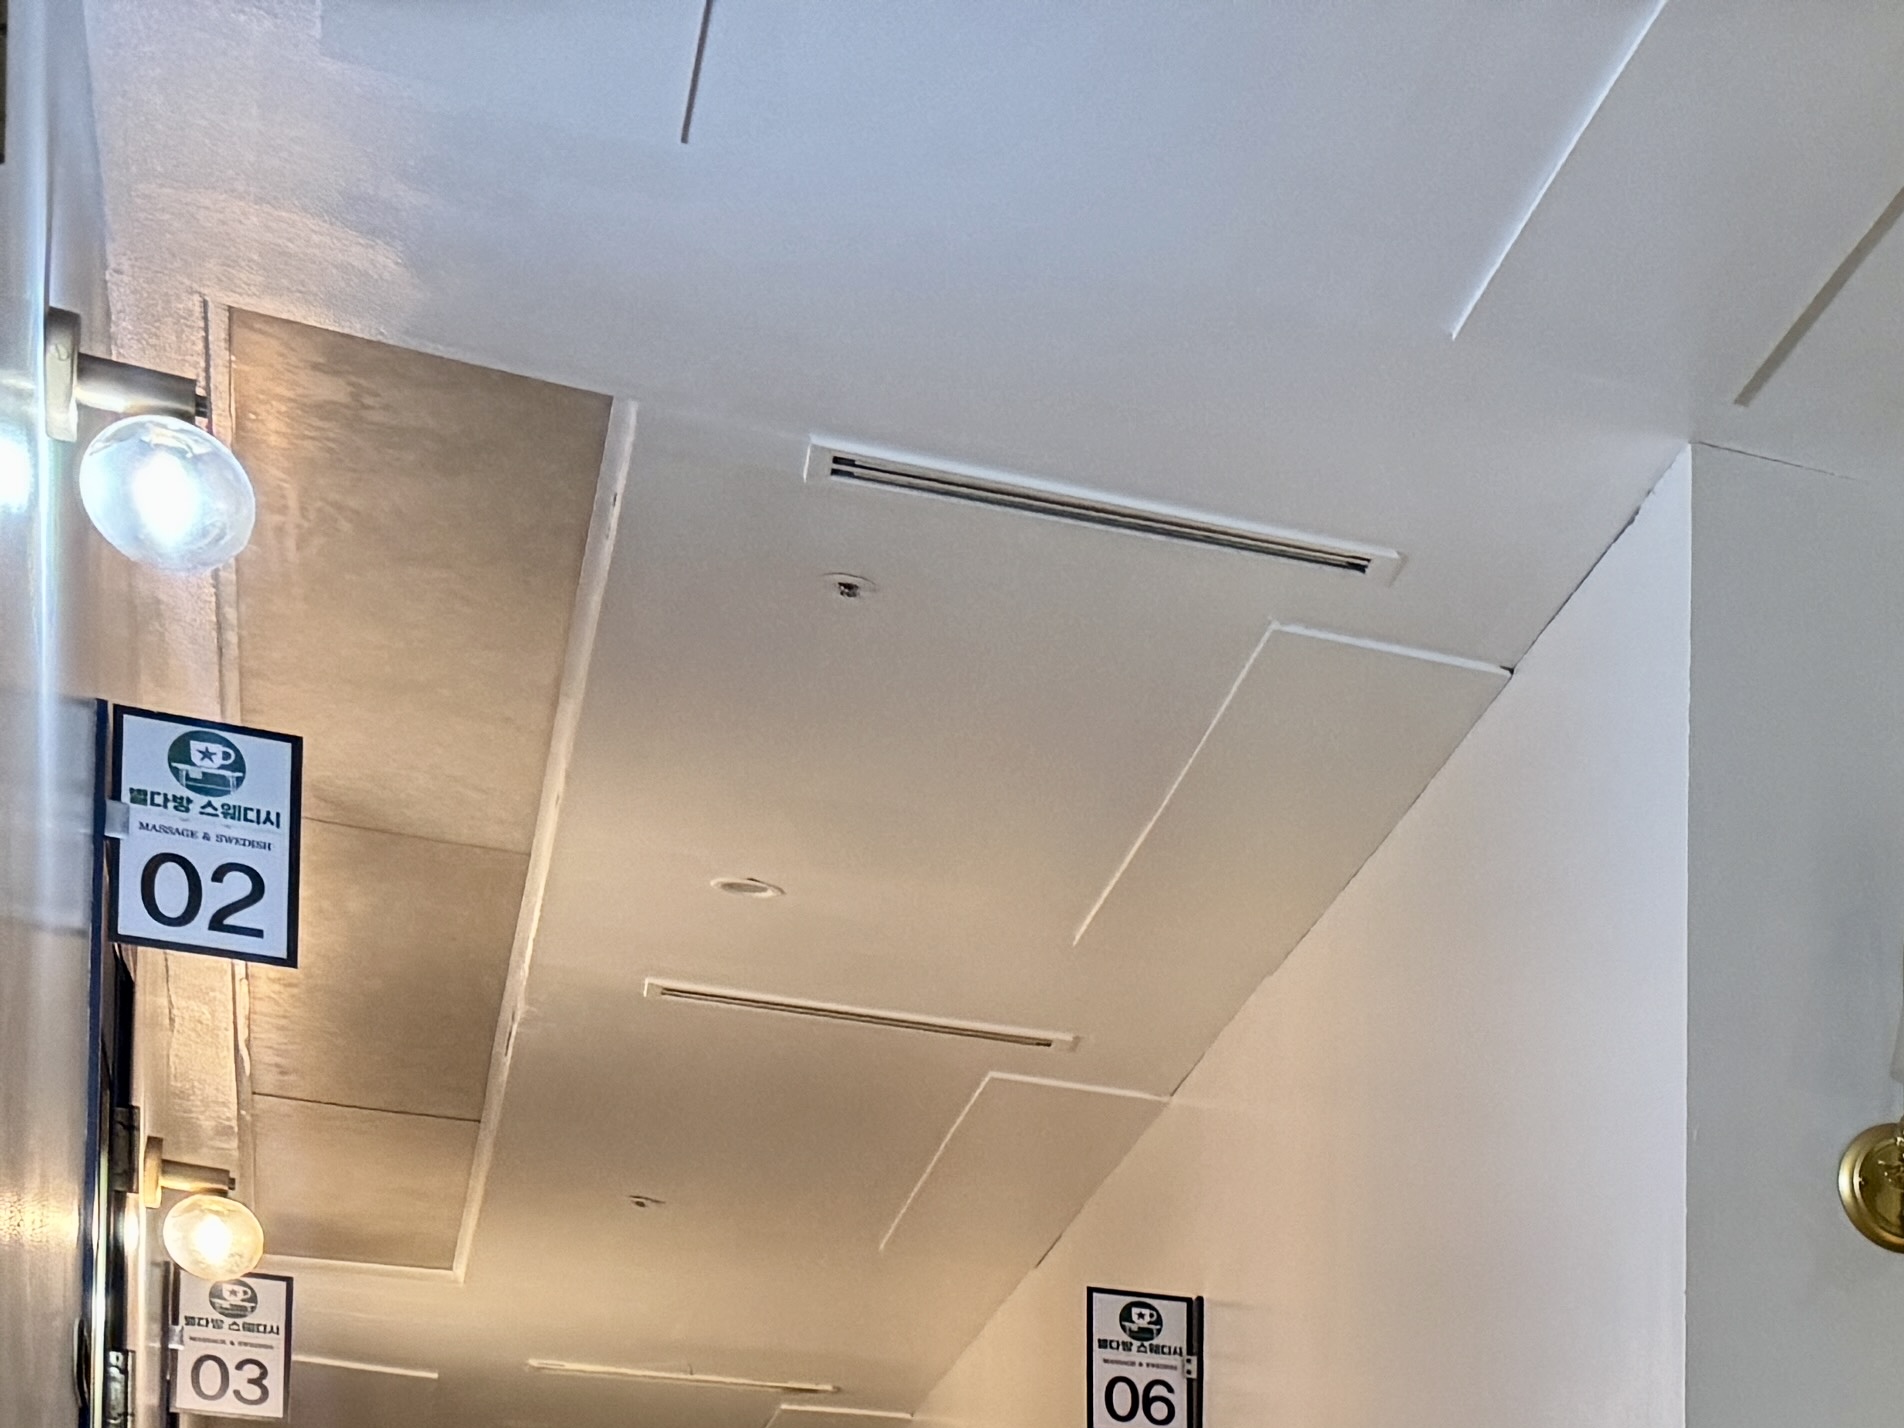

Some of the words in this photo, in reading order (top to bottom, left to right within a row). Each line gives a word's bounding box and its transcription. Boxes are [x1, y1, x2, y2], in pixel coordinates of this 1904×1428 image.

[138, 820, 198, 839] MASSAGE
[199, 799, 281, 829] 스웨디시
[140, 852, 266, 939] 02
[191, 1354, 270, 1405] 03
[1105, 1375, 1176, 1426] 06
